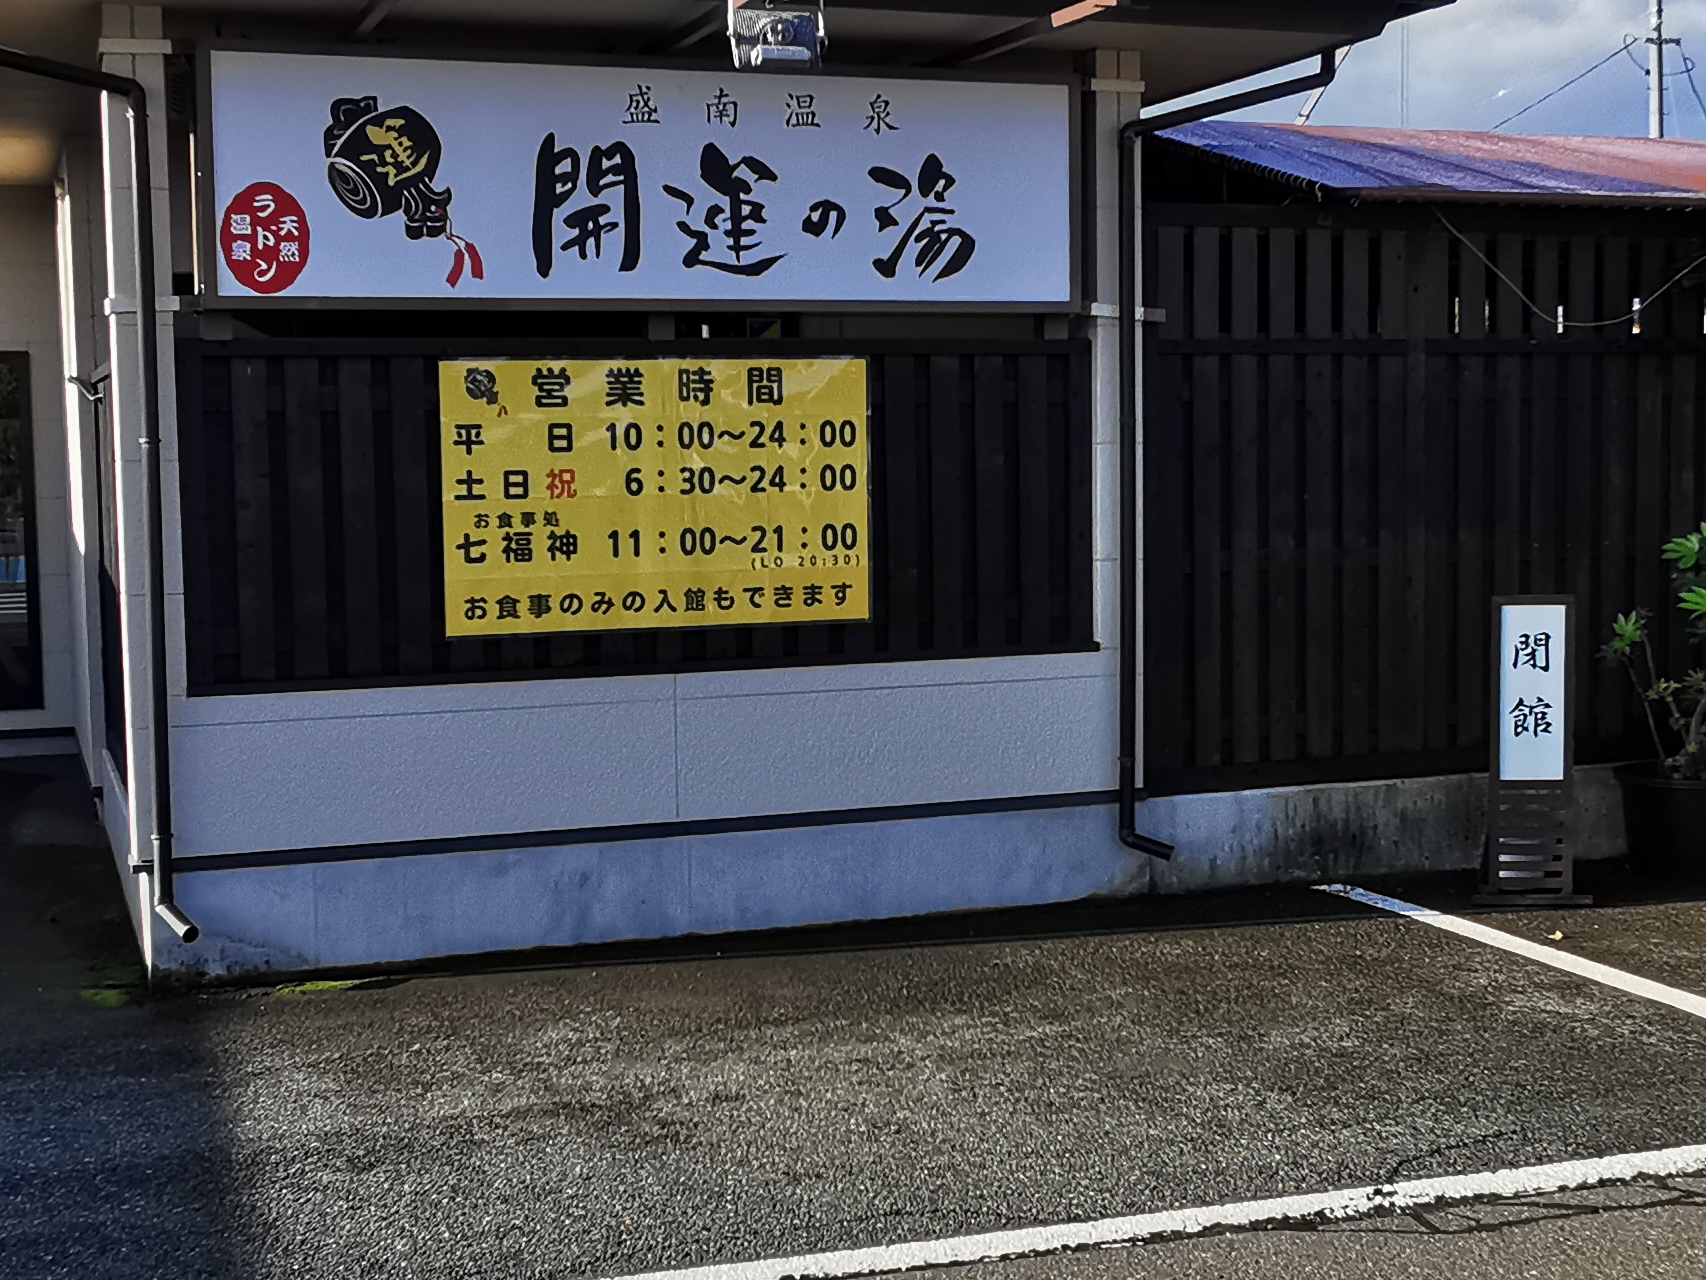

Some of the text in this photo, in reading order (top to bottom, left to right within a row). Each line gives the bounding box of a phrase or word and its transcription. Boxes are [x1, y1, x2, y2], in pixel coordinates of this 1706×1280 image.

[622, 83, 900, 135] 盛南温泉
[532, 131, 976, 283] 開運の湯
[230, 213, 252, 261] 温泉
[253, 194, 278, 282] ラドン
[278, 215, 300, 262] 天然
[531, 367, 784, 408] 営業時間
[454, 468, 578, 501] 土日祝
[473, 510, 561, 529] お食事処
[455, 530, 578, 565] 七福神
[463, 580, 854, 621] お食事のみの入館もできます
[1508, 631, 1553, 738] 閉館
